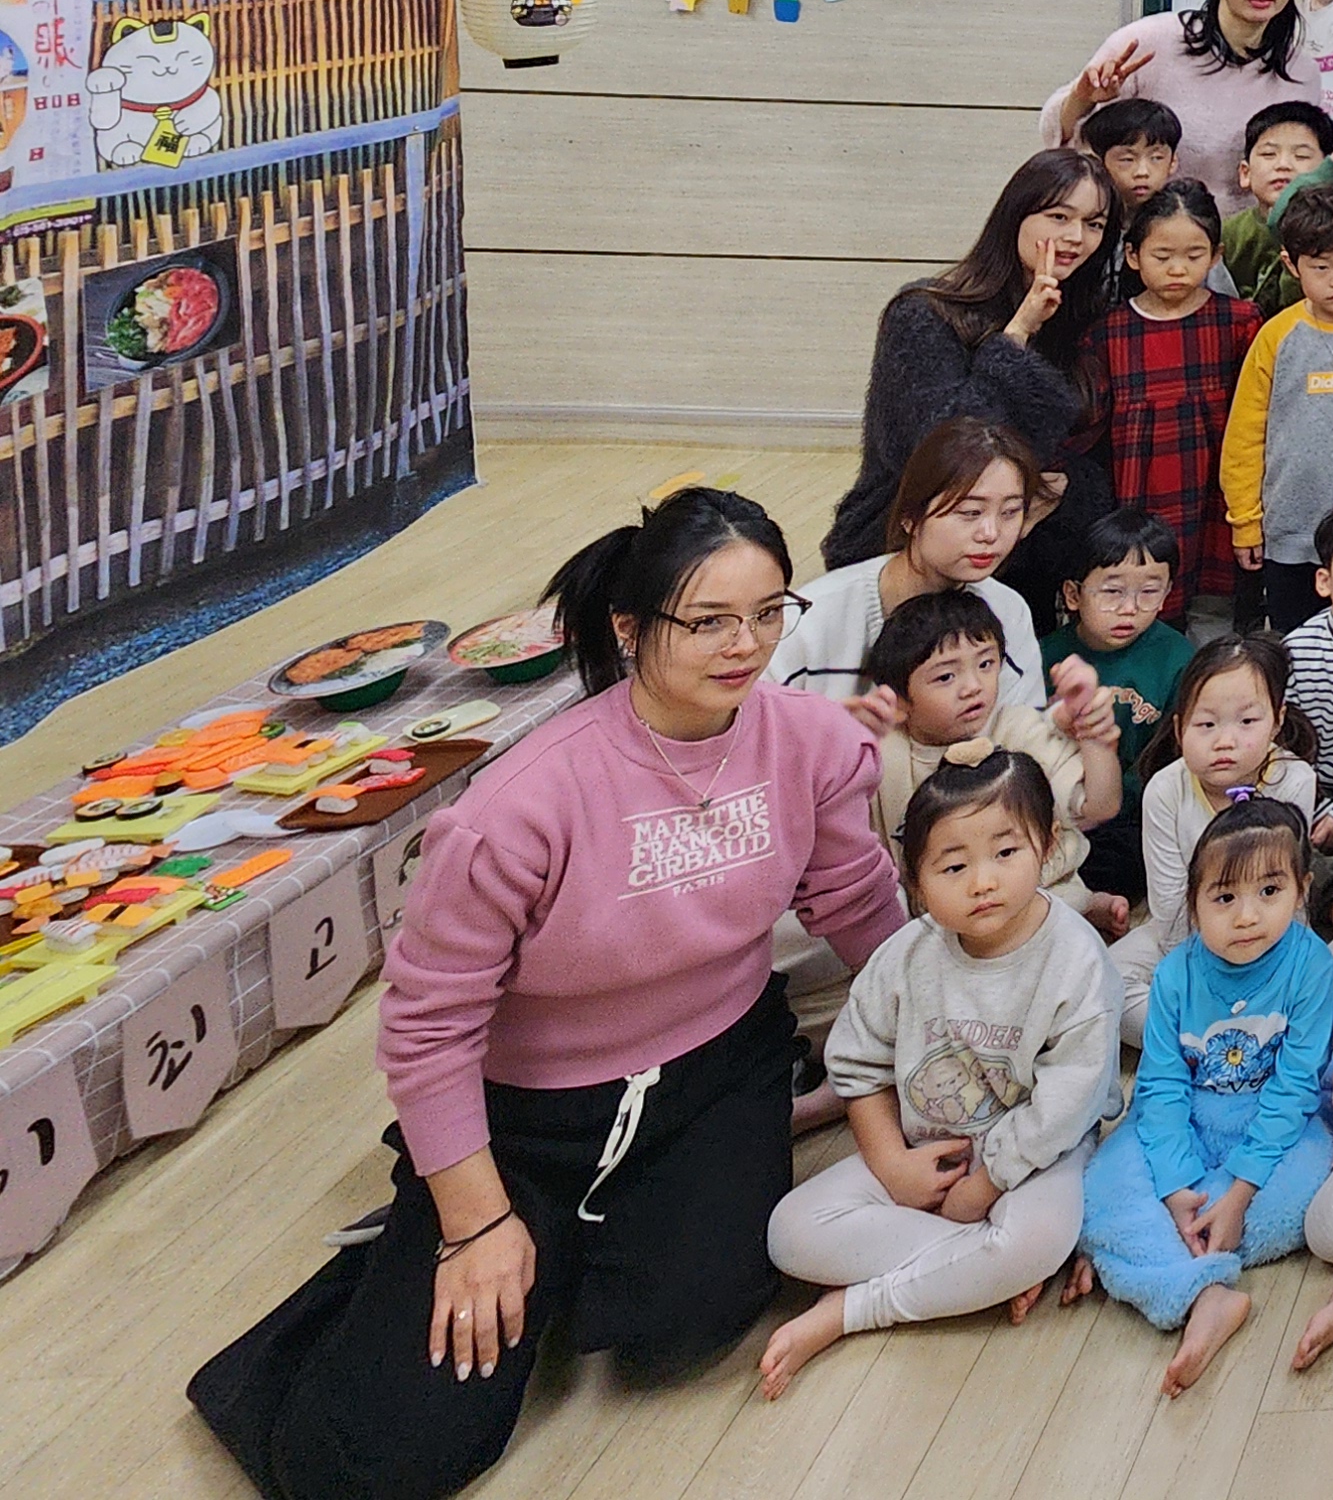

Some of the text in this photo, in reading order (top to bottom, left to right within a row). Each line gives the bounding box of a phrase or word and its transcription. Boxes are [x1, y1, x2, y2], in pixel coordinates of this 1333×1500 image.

[154, 130, 181, 154] 福
[673, 871, 726, 898] PARIS
[923, 1017, 1024, 1051] KYDEE
